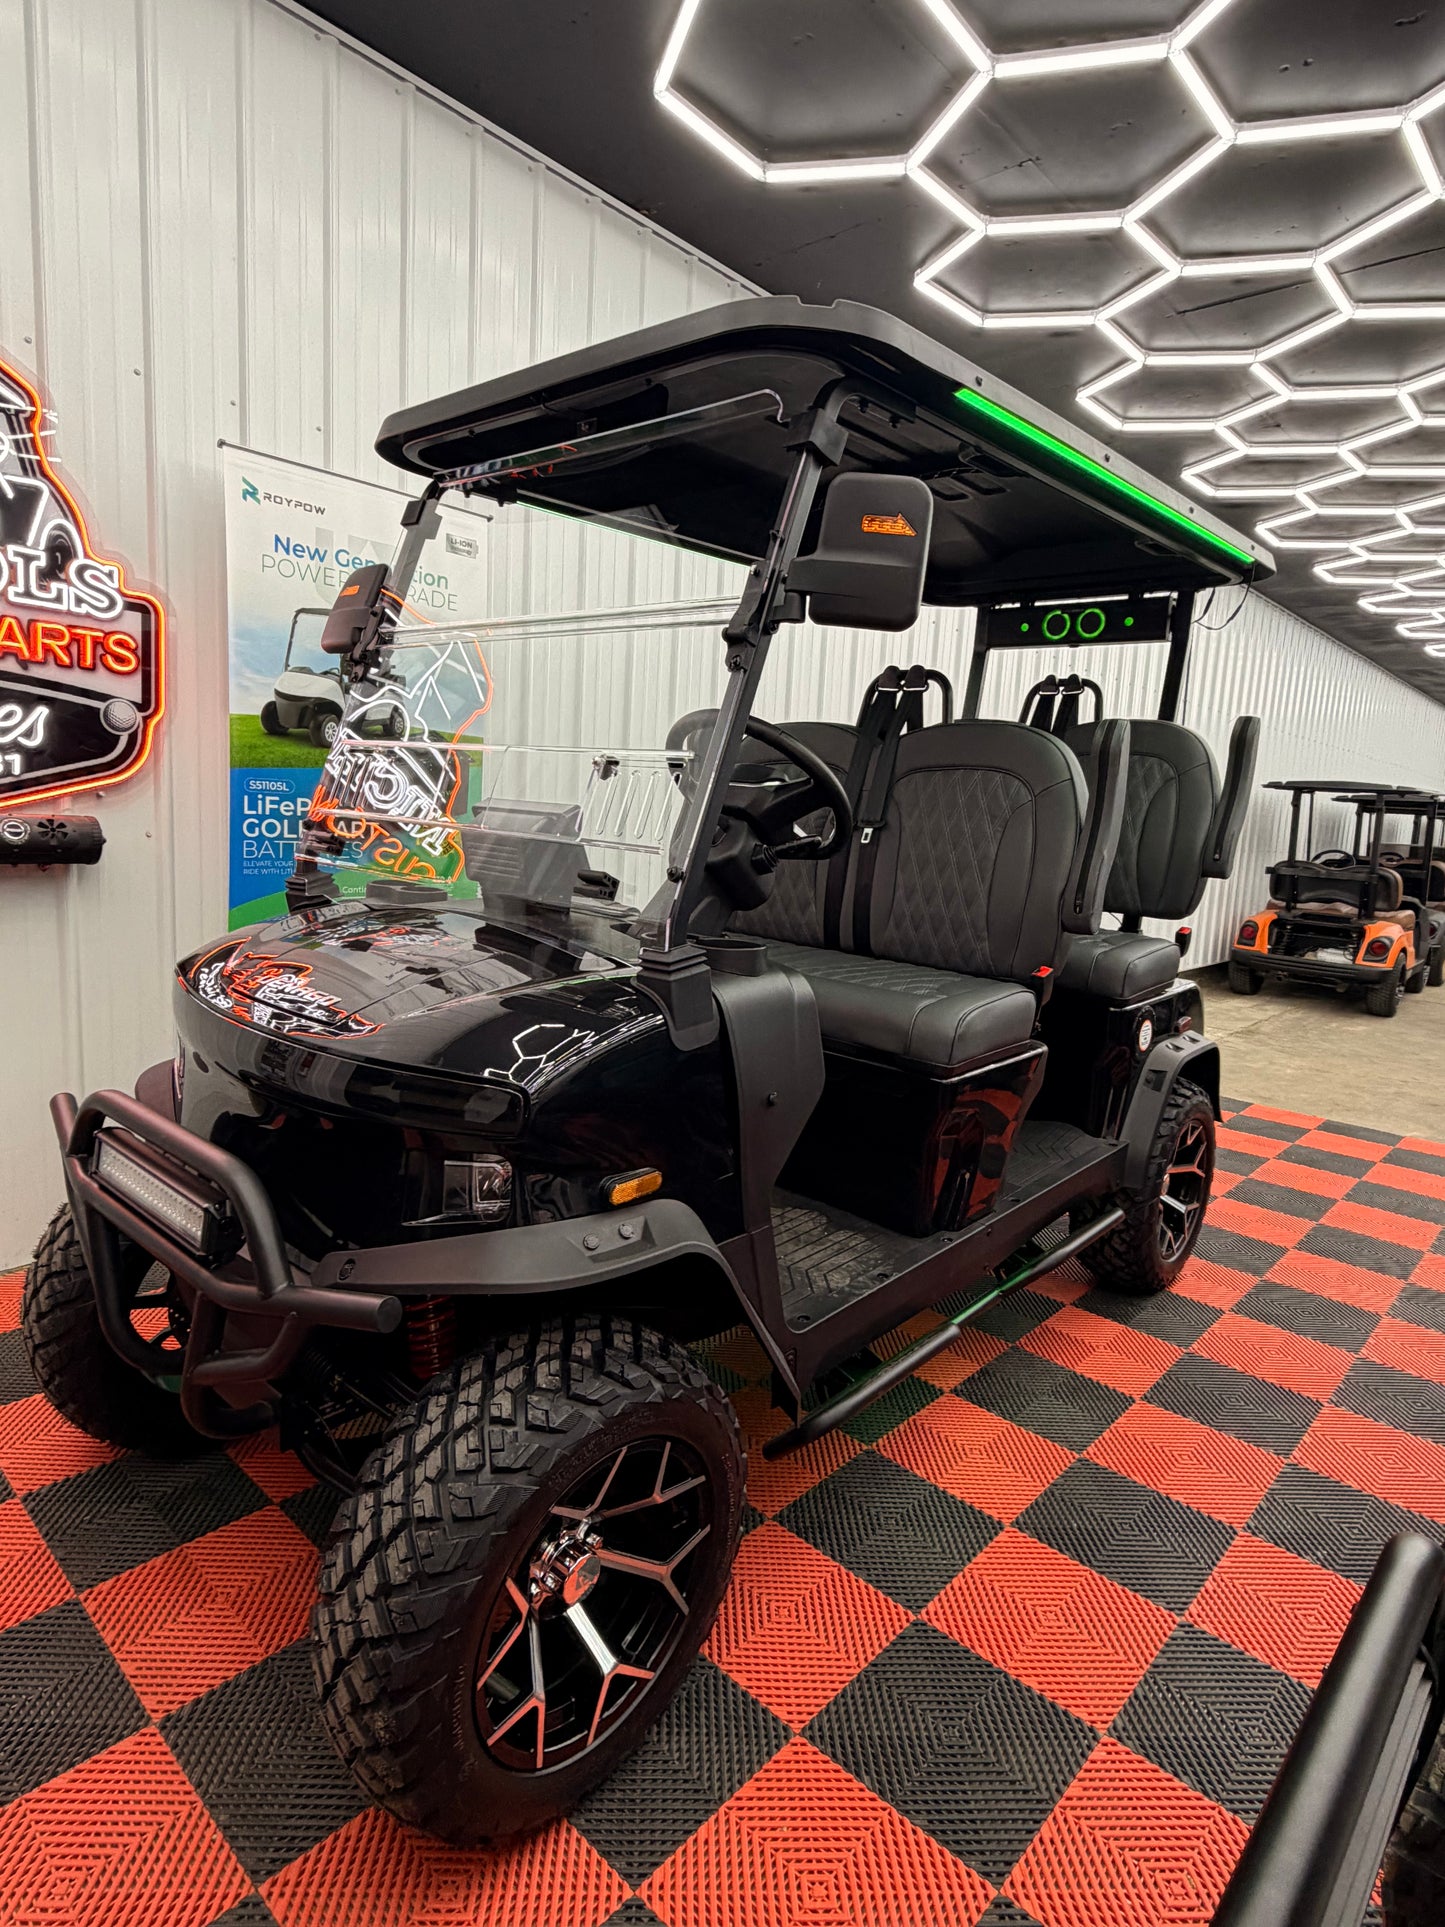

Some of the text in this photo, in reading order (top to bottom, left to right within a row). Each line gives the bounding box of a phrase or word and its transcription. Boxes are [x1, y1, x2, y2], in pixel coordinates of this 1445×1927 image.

[263, 491, 326, 516] ROYPOW
[274, 534, 327, 563] New
[243, 794, 312, 816] LiFeP
[243, 860, 272, 868] ELEVATE
